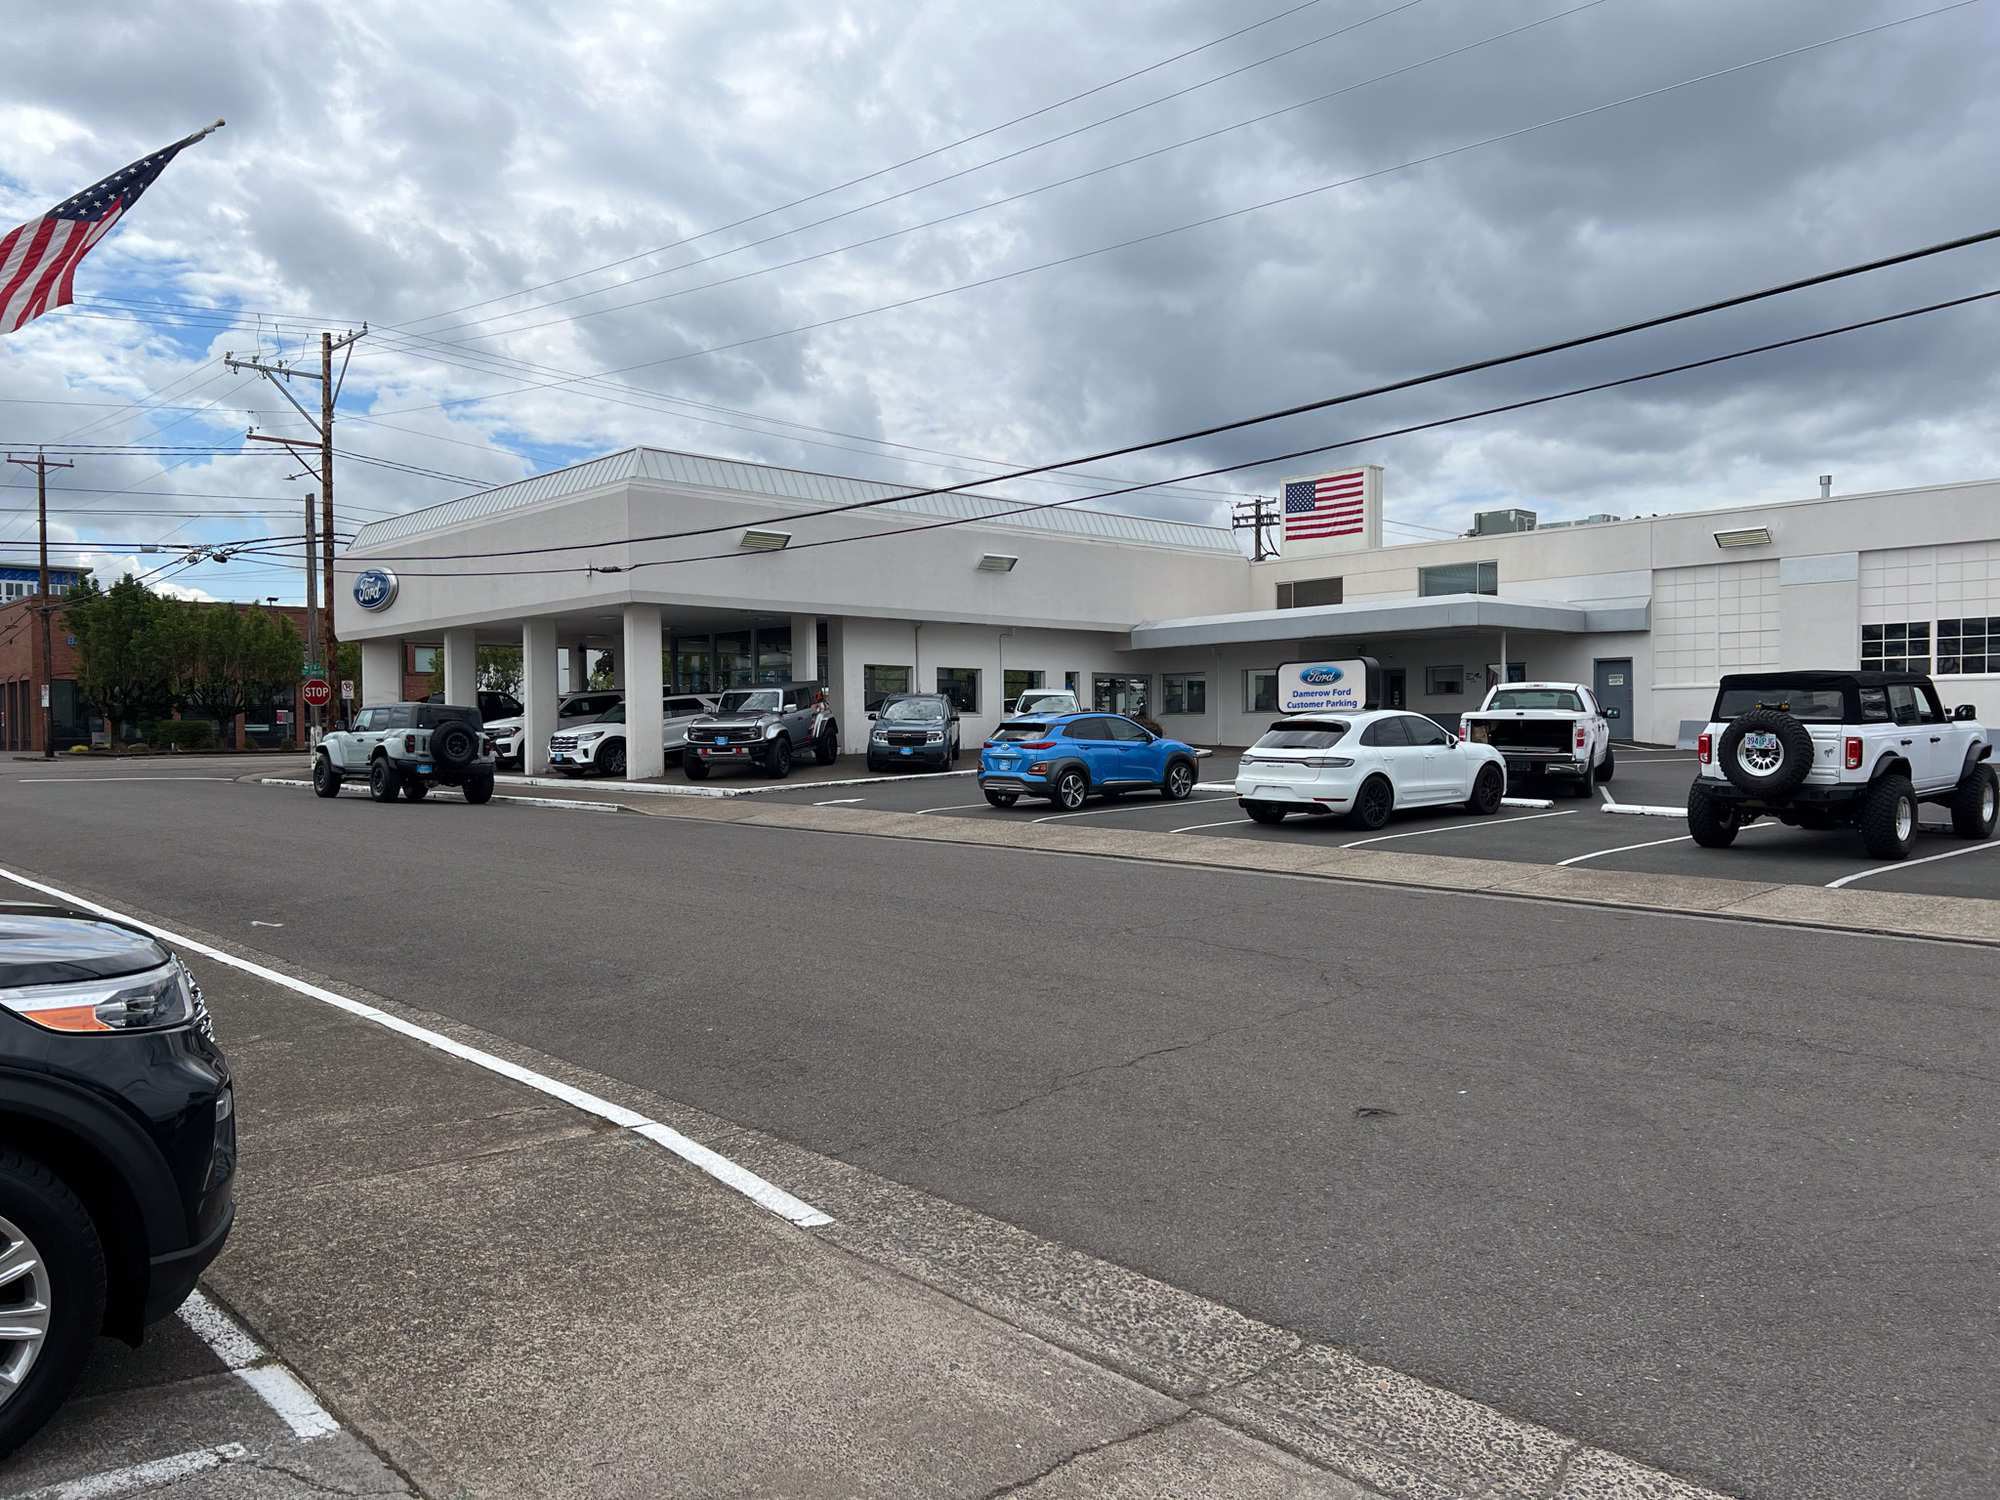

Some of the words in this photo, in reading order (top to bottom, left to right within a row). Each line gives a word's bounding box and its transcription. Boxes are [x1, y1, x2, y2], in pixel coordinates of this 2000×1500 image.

[358, 577, 381, 601] Ford
[1307, 670, 1336, 683] Ford
[305, 687, 329, 697] STOP
[1292, 689, 1330, 698] Damerow
[1332, 688, 1351, 697] Ford
[1286, 701, 1324, 709] Customer
[1326, 700, 1358, 709] Parking
